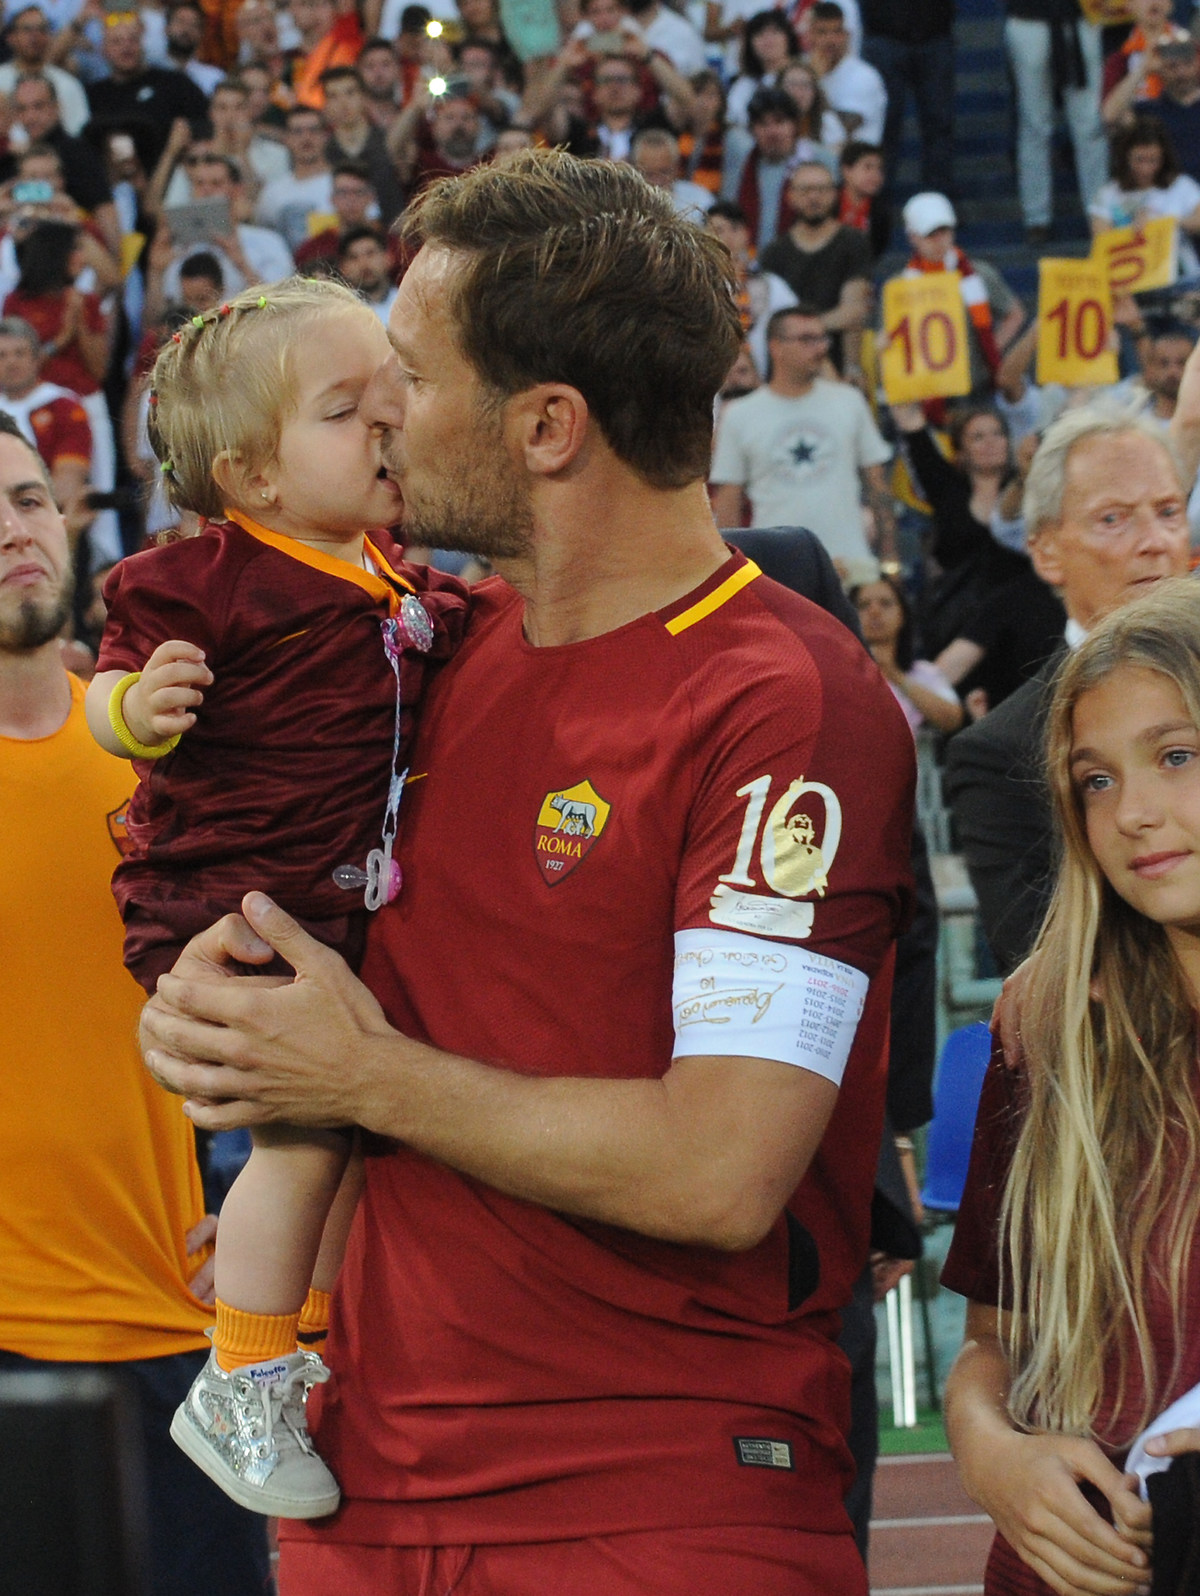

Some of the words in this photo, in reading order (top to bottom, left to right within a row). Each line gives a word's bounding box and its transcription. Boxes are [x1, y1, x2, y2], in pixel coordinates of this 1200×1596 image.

[888, 309, 956, 376] 10
[1047, 298, 1107, 361] 10
[537, 834, 583, 858] ROMA
[545, 859, 565, 872] 1927
[719, 775, 842, 897] 10
